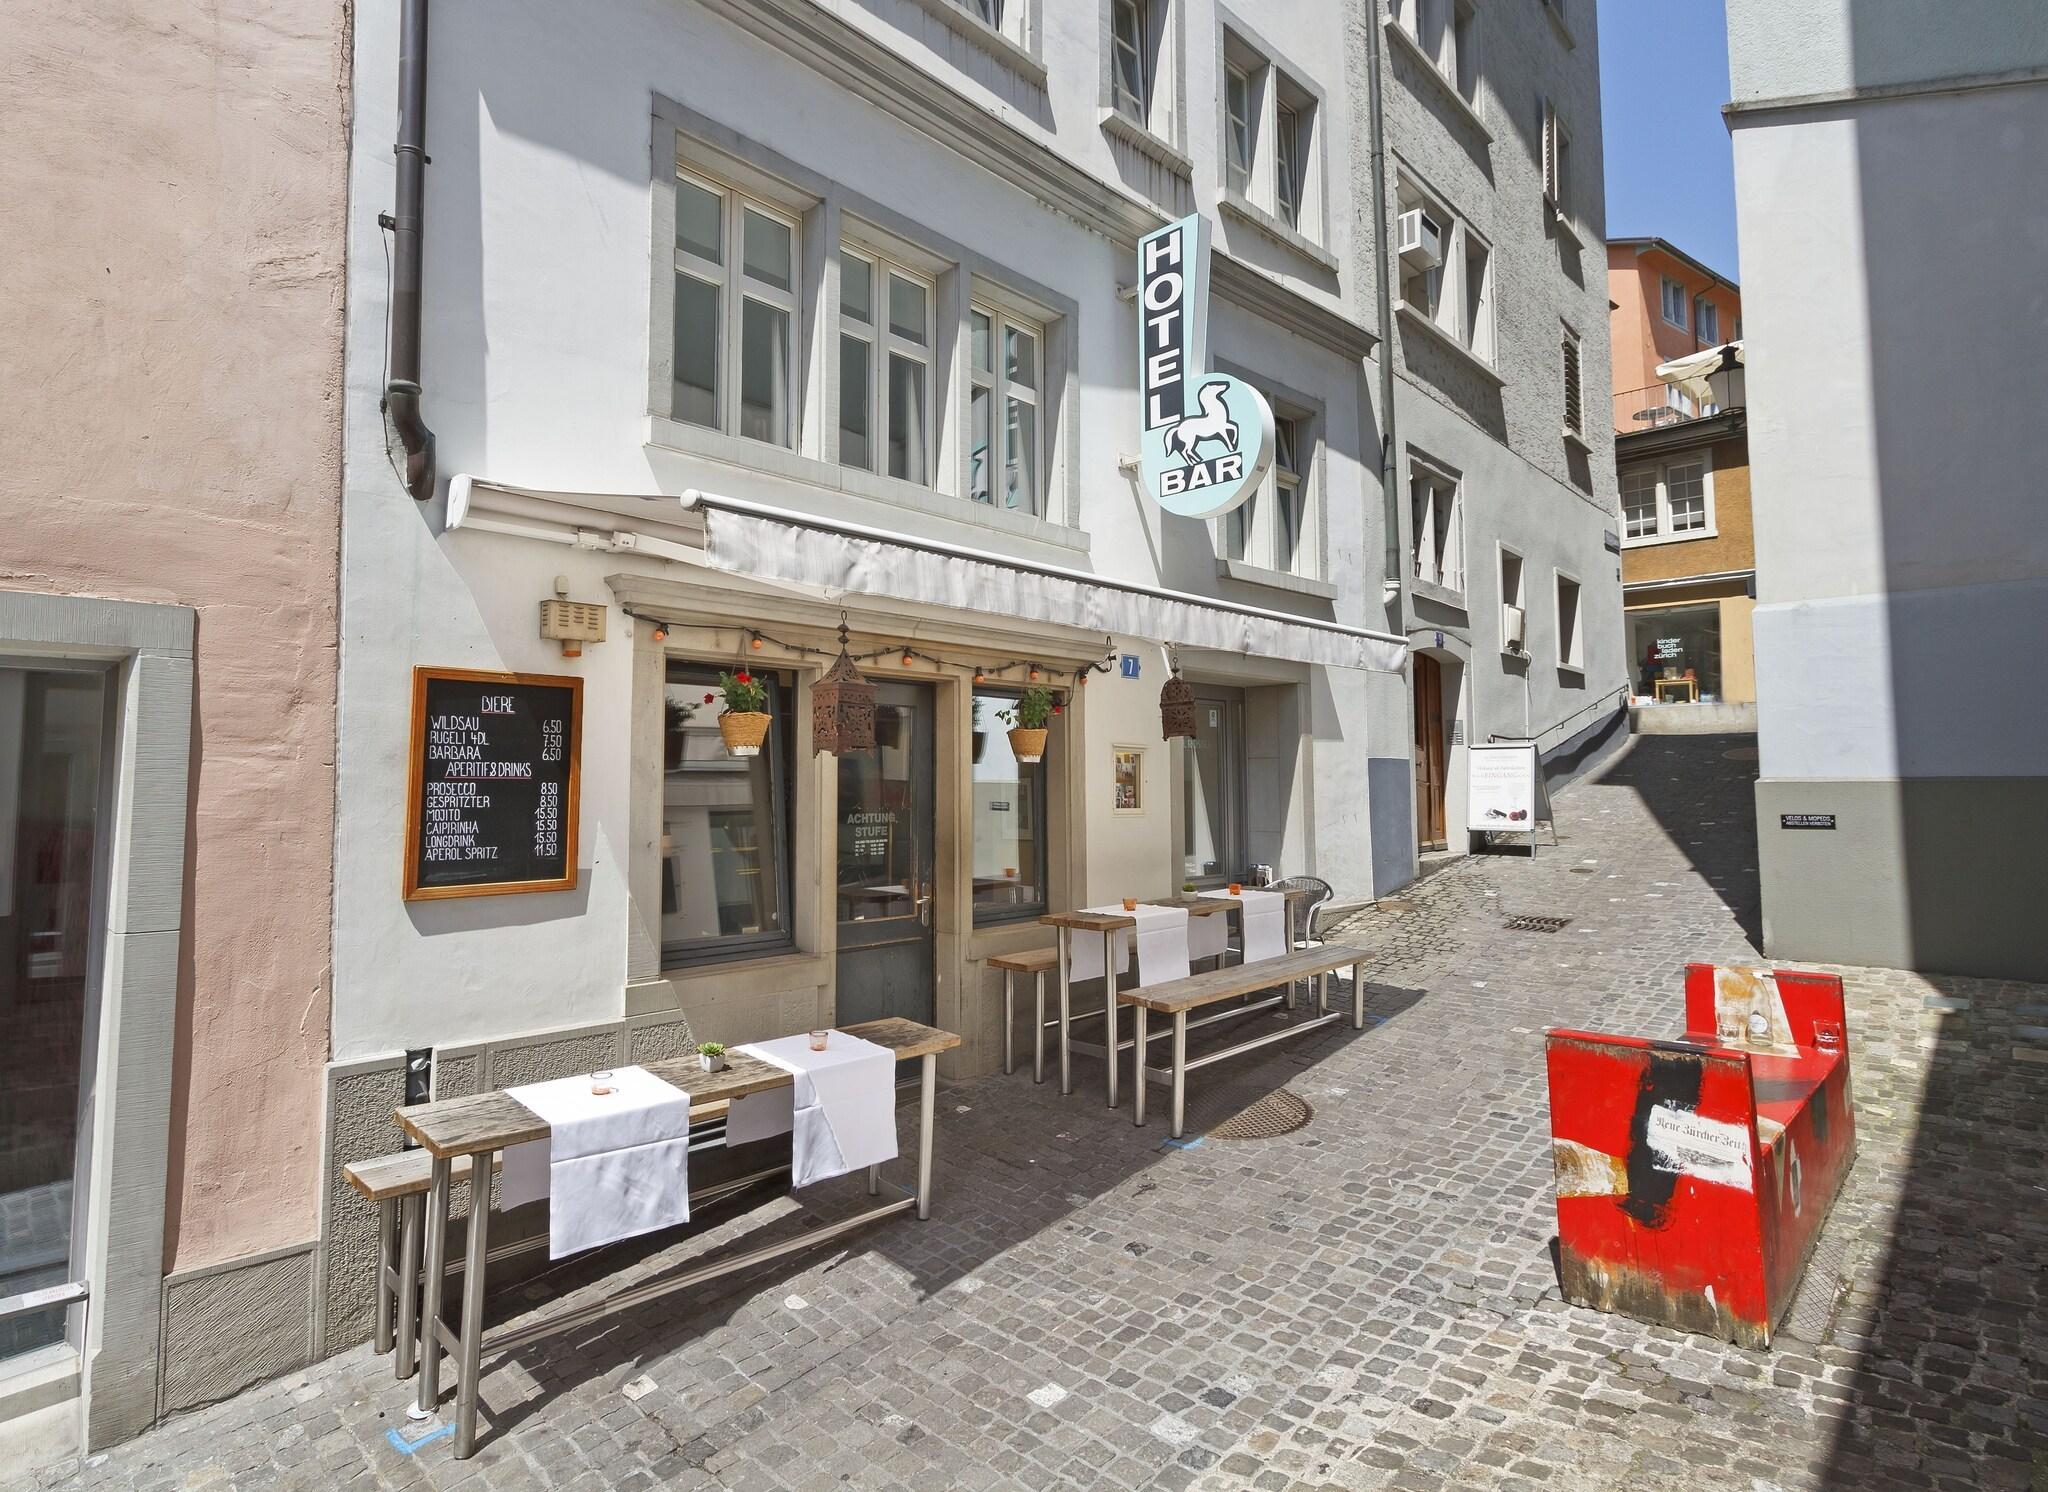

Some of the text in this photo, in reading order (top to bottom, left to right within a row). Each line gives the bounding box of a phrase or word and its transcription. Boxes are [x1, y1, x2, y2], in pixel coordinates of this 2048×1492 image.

[1144, 229, 1183, 430] HOTEL
[1161, 455, 1242, 497] BAR
[1128, 659, 1133, 675] 7
[481, 696, 516, 713] BIERE
[431, 715, 562, 733] WILDSAU 6.50
[471, 732, 491, 745] 4DL
[543, 735, 562, 748] 7.50
[429, 745, 561, 761] BARBARA 6.50
[498, 762, 532, 777] DRINKS
[426, 782, 558, 796] PROSECCO 8.50
[426, 796, 558, 808] GESPRITZTER 8.50
[426, 808, 558, 821] MOJITO 15.50
[426, 820, 557, 835] CAIPIRINHA 15.50
[855, 826, 888, 837] STUFE
[425, 832, 557, 848] LONGDRINK 15.50
[424, 844, 557, 861] APEROL SPRITZ 11.50
